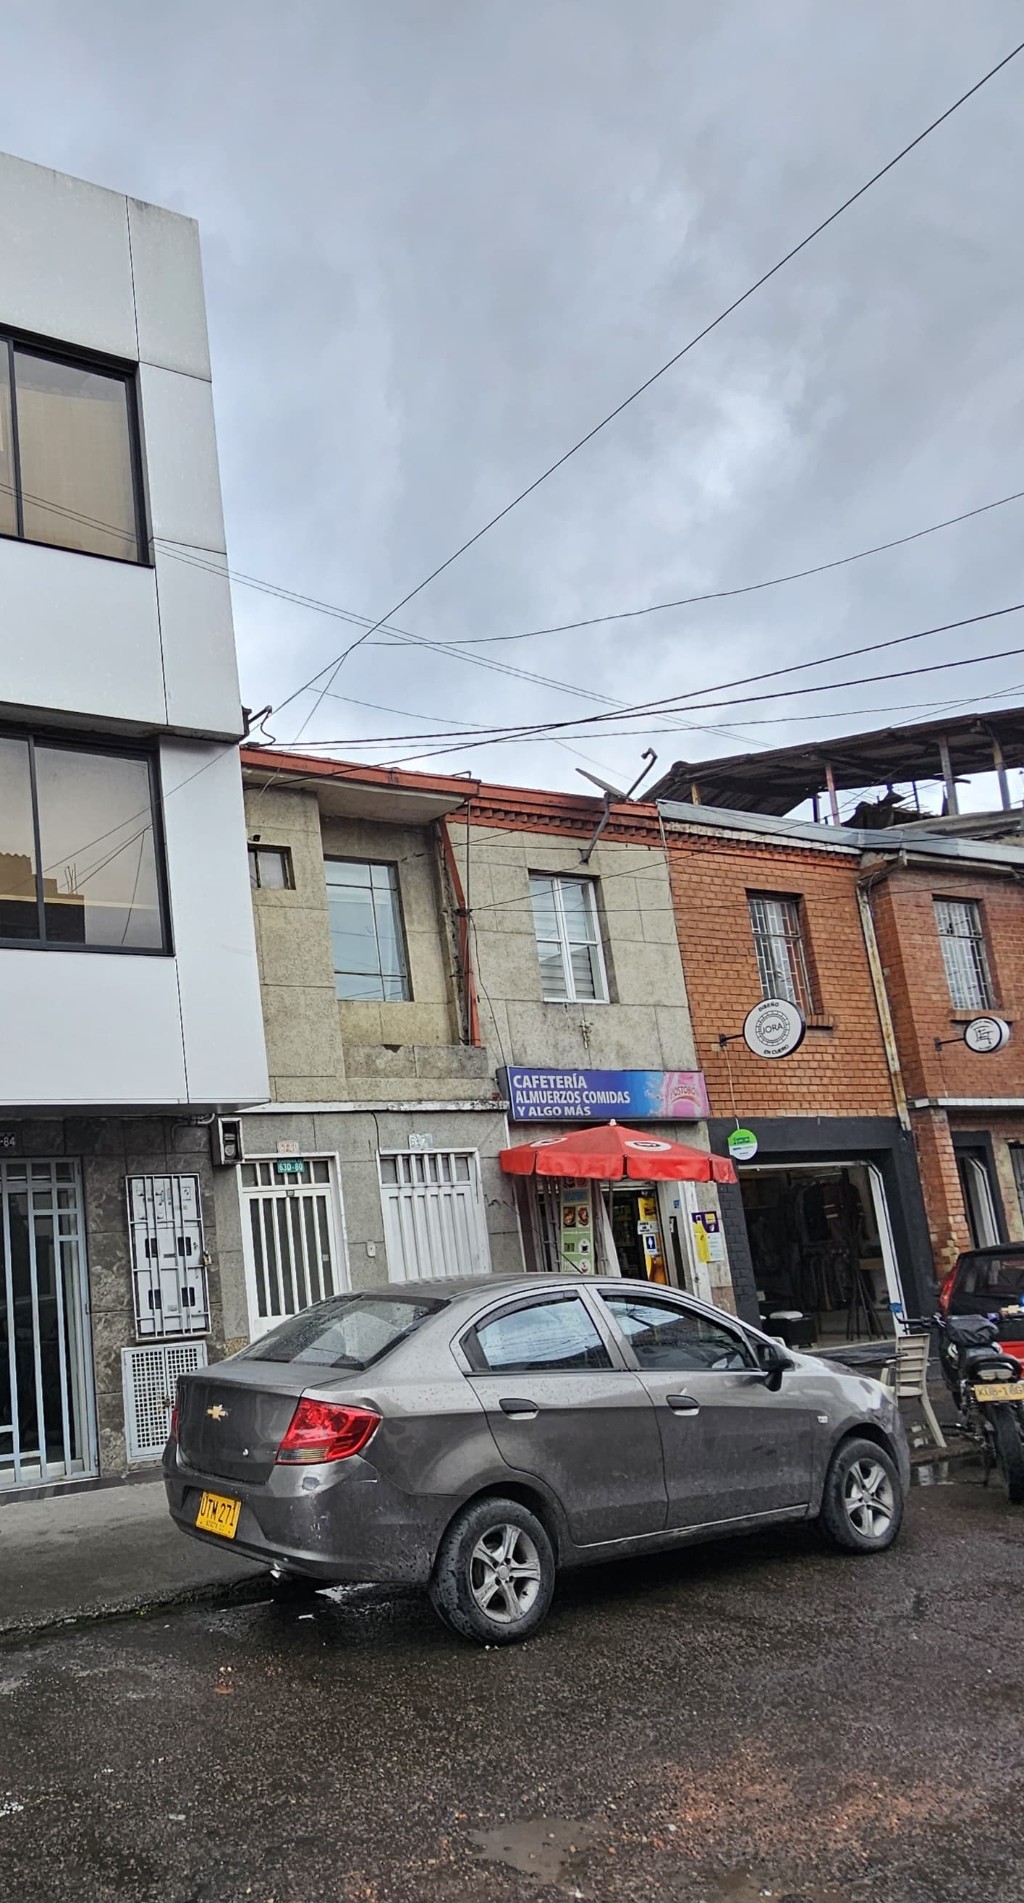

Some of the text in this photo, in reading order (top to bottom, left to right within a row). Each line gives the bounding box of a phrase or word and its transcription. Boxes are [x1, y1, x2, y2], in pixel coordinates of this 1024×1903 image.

[761, 1023, 783, 1035] JORA
[513, 1073, 588, 1089] CAFETERÍA
[515, 1090, 631, 1104] ALMUERZOS COMIDAS
[517, 1104, 591, 1116] Y ALGO MÁS
